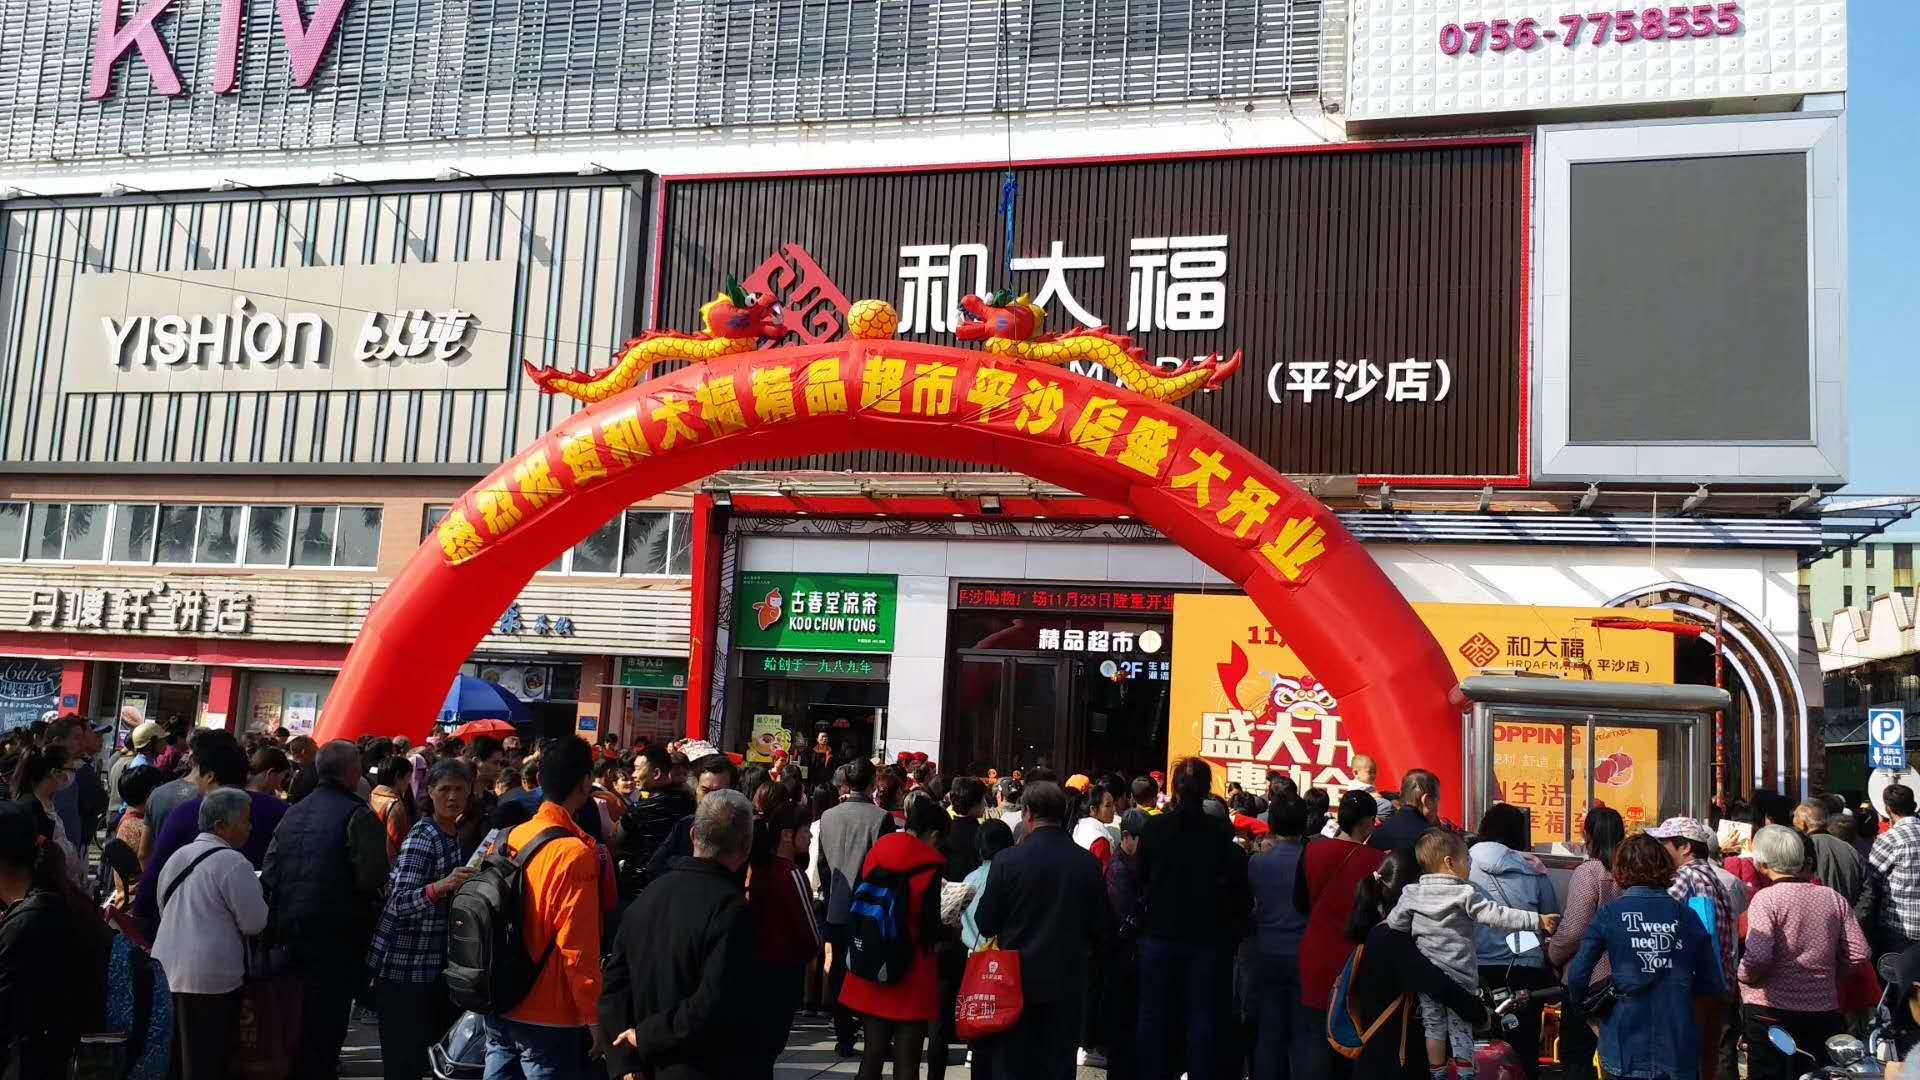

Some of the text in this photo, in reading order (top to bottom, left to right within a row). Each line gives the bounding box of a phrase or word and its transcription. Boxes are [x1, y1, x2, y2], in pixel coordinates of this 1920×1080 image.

[1439, 2, 1743, 55] 0756-7758555
[899, 234, 1228, 334] 和大福
[358, 308, 473, 361] 以纯
[791, 590, 878, 615] 古春堂凉茶
[788, 617, 876, 633] KOO CHUN TONG
[1248, 626, 1286, 648] 11
[1039, 629, 1133, 653] 精品超市
[1507, 636, 1585, 658] 和大福
[763, 656, 872, 674] 始创于一九八九年
[1120, 661, 1143, 679] 2F
[1507, 659, 1582, 671] HRDAFM
[1200, 708, 1354, 768] 盛大开
[1880, 717, 1894, 741] P
[1883, 755, 1902, 766] 出口
[1501, 780, 1565, 807] 生活
